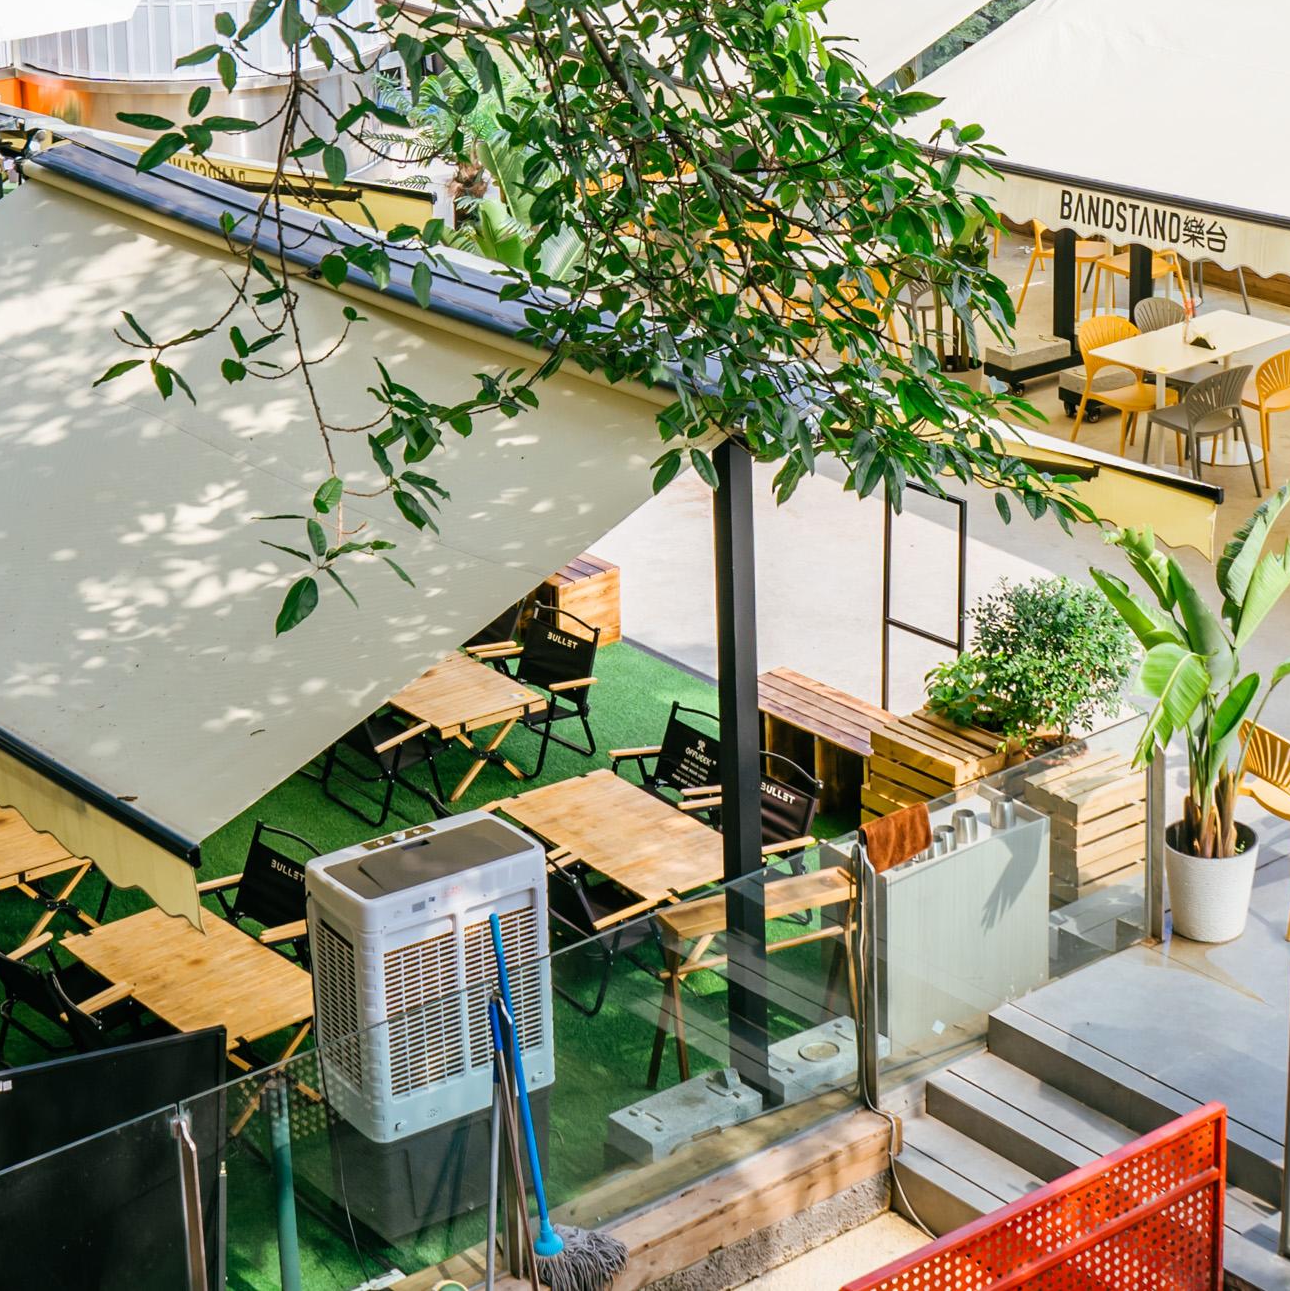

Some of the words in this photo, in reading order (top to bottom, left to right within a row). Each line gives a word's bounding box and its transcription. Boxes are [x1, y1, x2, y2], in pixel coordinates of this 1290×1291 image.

[1059, 189, 1228, 253] BANDSTAND樂台
[546, 631, 579, 650] BULLET
[270, 858, 306, 883] BULLET
